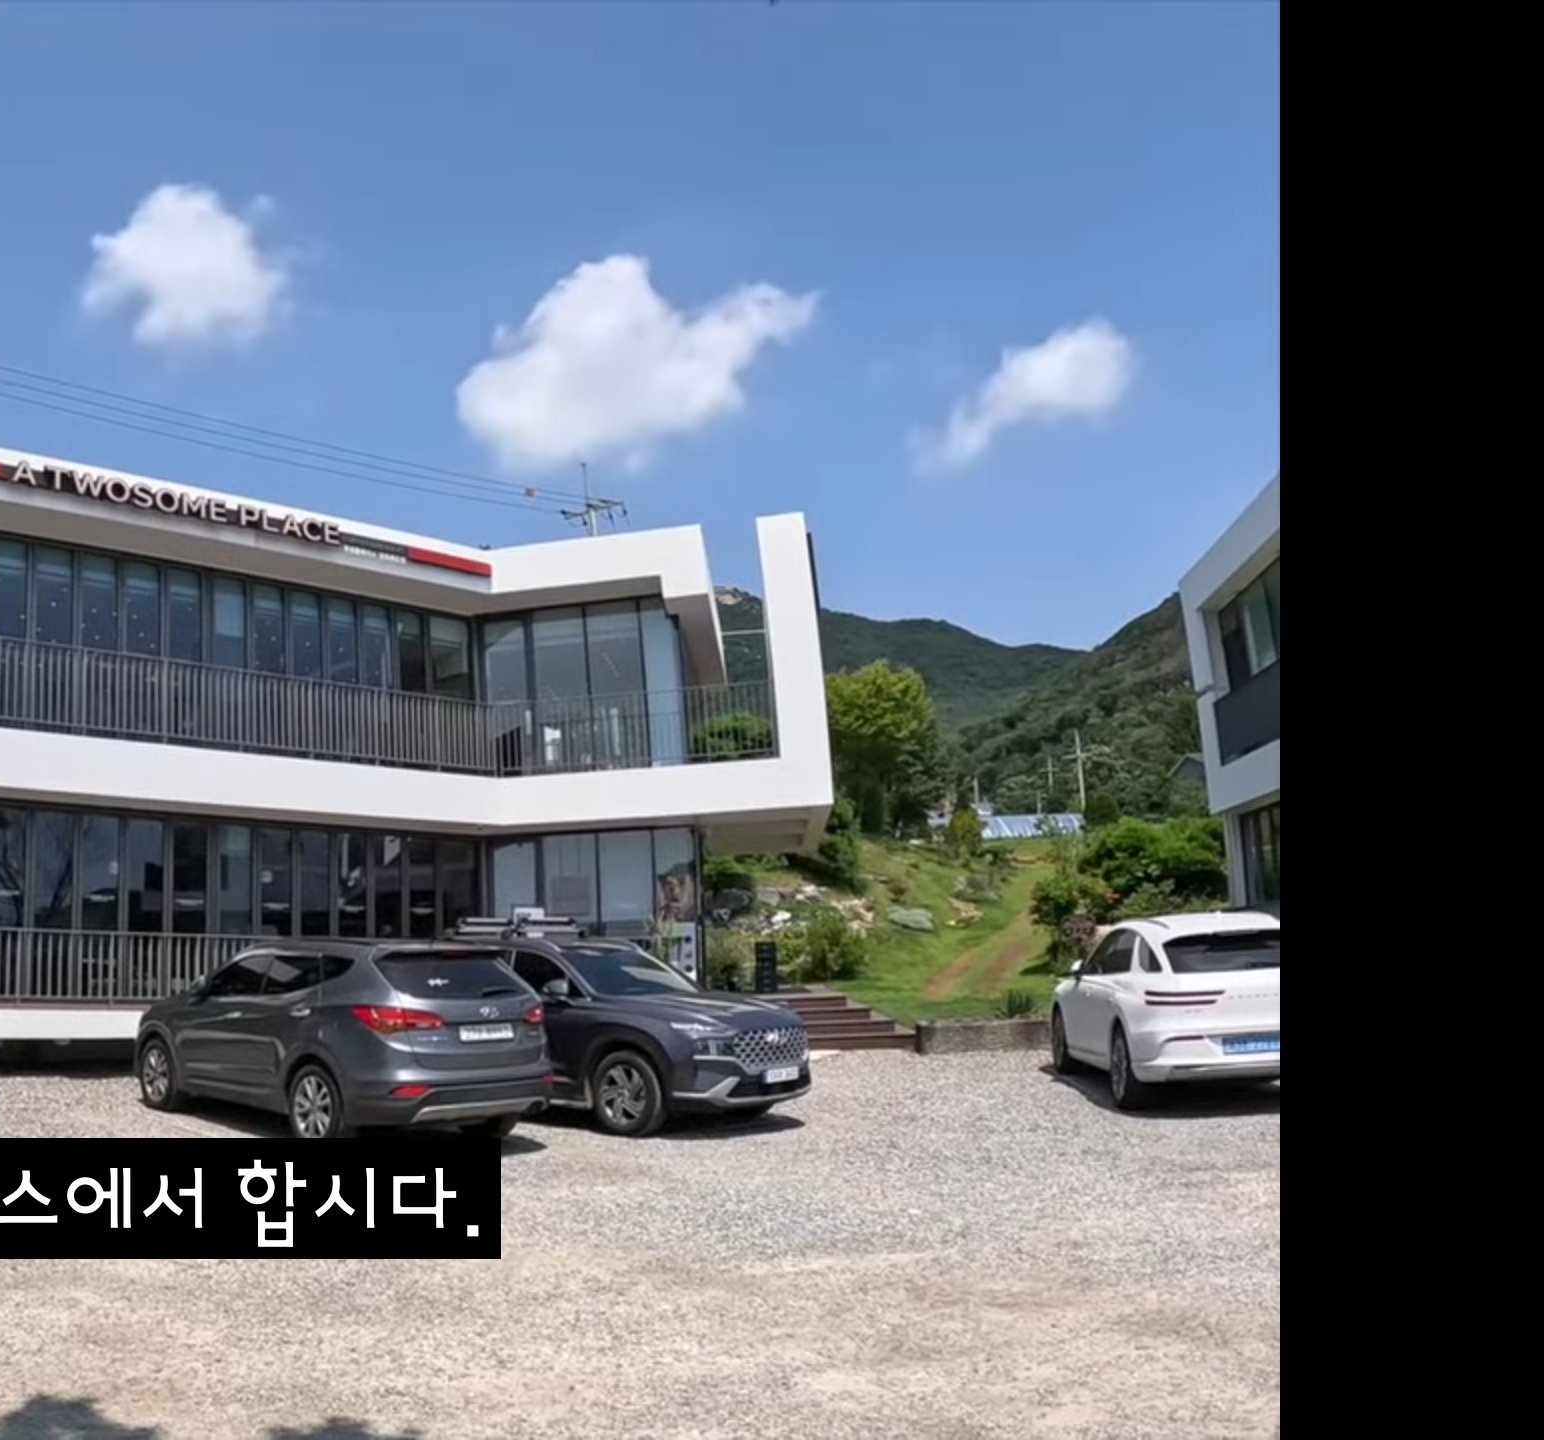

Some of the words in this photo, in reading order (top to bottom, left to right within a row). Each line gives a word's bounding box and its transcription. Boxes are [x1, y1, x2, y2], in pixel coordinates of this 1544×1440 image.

[12, 460, 37, 486] A
[45, 464, 228, 523] TWOSOME
[238, 503, 341, 545] PLACE
